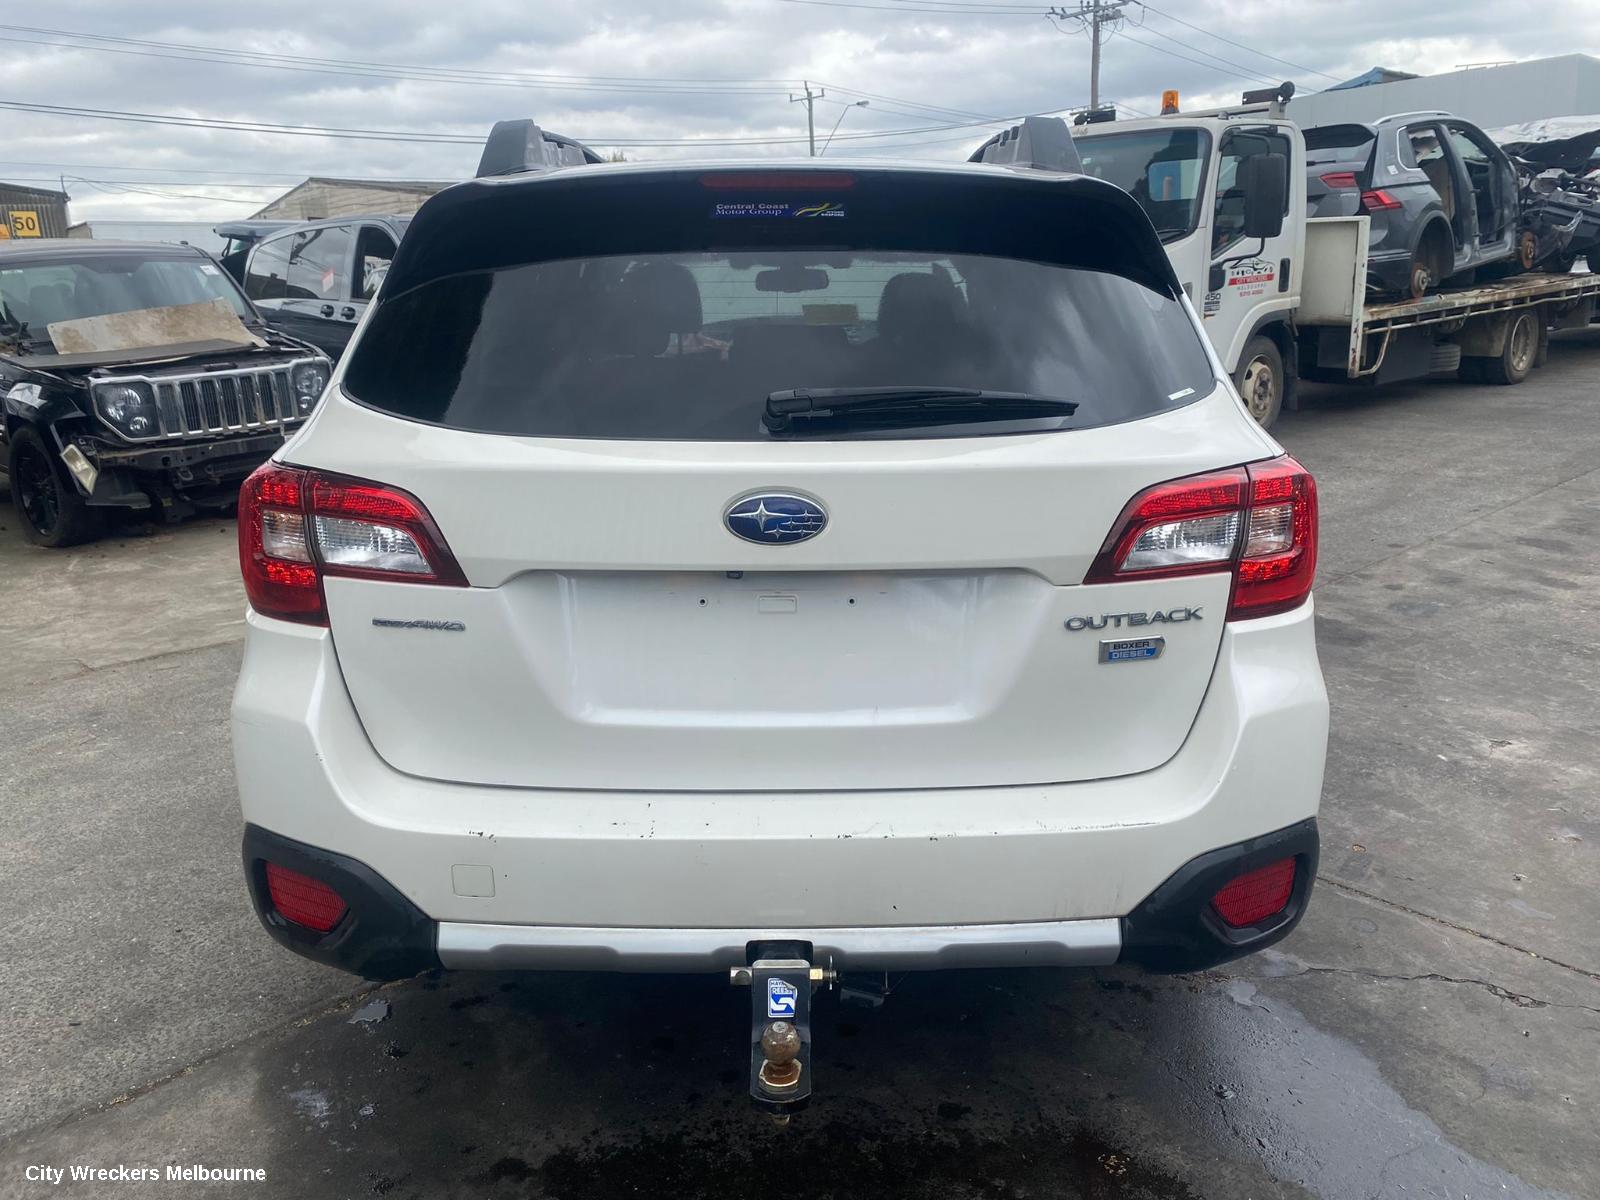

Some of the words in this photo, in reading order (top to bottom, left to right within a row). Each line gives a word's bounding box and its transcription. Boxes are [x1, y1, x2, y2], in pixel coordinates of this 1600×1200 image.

[749, 208, 782, 217] Group
[14, 216, 36, 231] 50
[1204, 292, 1221, 300] 450
[1064, 605, 1204, 631] OUTBACK
[1113, 641, 1150, 650] BOXER
[1111, 649, 1151, 659] DIESEL
